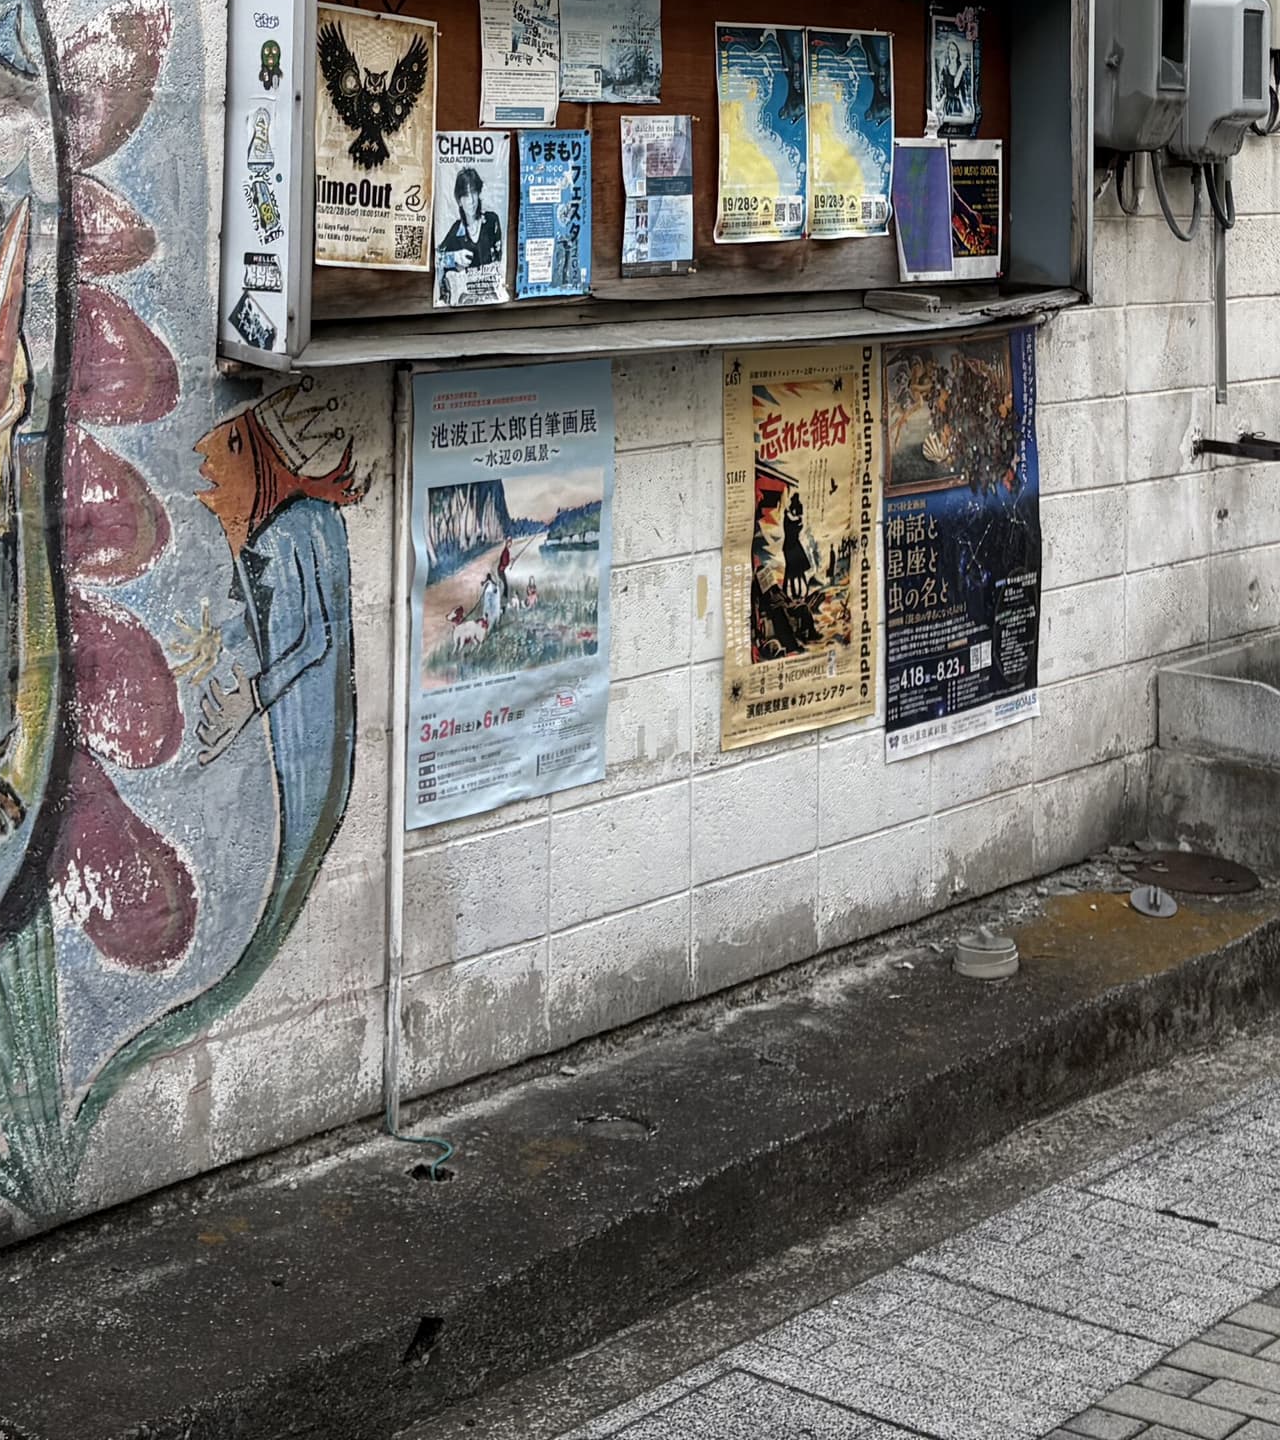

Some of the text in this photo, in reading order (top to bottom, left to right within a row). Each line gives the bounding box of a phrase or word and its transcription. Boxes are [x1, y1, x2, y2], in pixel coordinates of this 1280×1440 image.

[439, 136, 494, 155] CHABO
[528, 140, 581, 162] やまもり
[359, 178, 392, 209] Out
[431, 408, 598, 449] 池波正太郎自筆画展
[759, 403, 850, 460] 忘れた領分
[726, 470, 747, 484] STAFF
[860, 346, 874, 698] Dum-dum-diddle-dum-diddle
[886, 512, 938, 548] 神話と
[887, 545, 938, 580] 星座と
[888, 576, 949, 614] 虫の名と
[901, 666, 924, 689] 4.18
